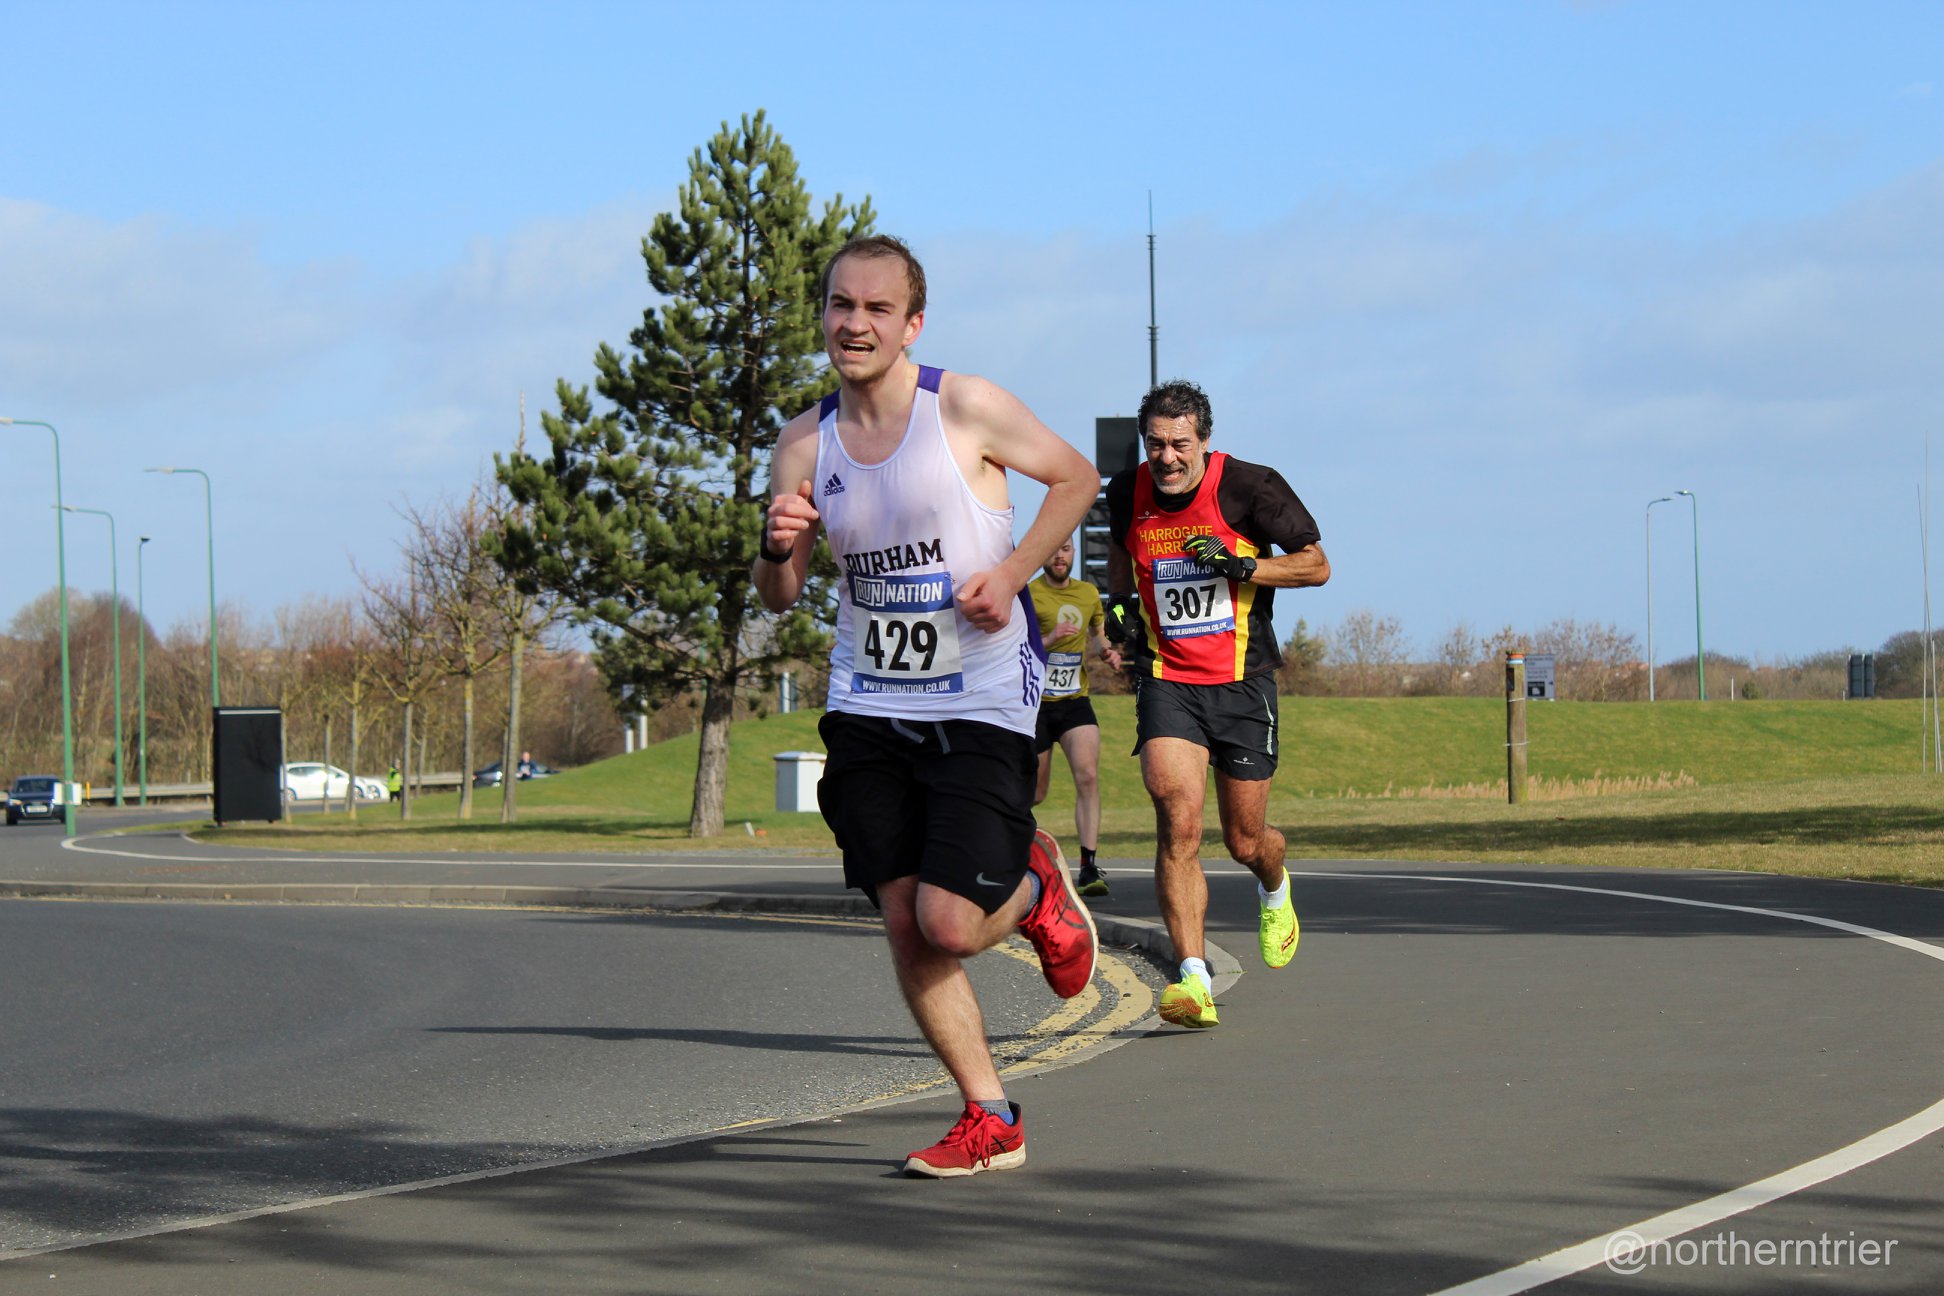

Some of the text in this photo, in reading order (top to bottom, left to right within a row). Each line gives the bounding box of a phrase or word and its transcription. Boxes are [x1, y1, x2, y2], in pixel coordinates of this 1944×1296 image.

[824, 485, 845, 496] adidas
[1140, 525, 1213, 542] HARROGATE
[843, 538, 944, 575] DURHAM
[1165, 584, 1217, 621] 307
[1166, 622, 1228, 636] WWW.RUNNATION.CO.UK
[865, 619, 938, 671] 429
[1049, 668, 1076, 687] 437
[862, 680, 950, 694] WWW.RUNNATION.CO.UK
